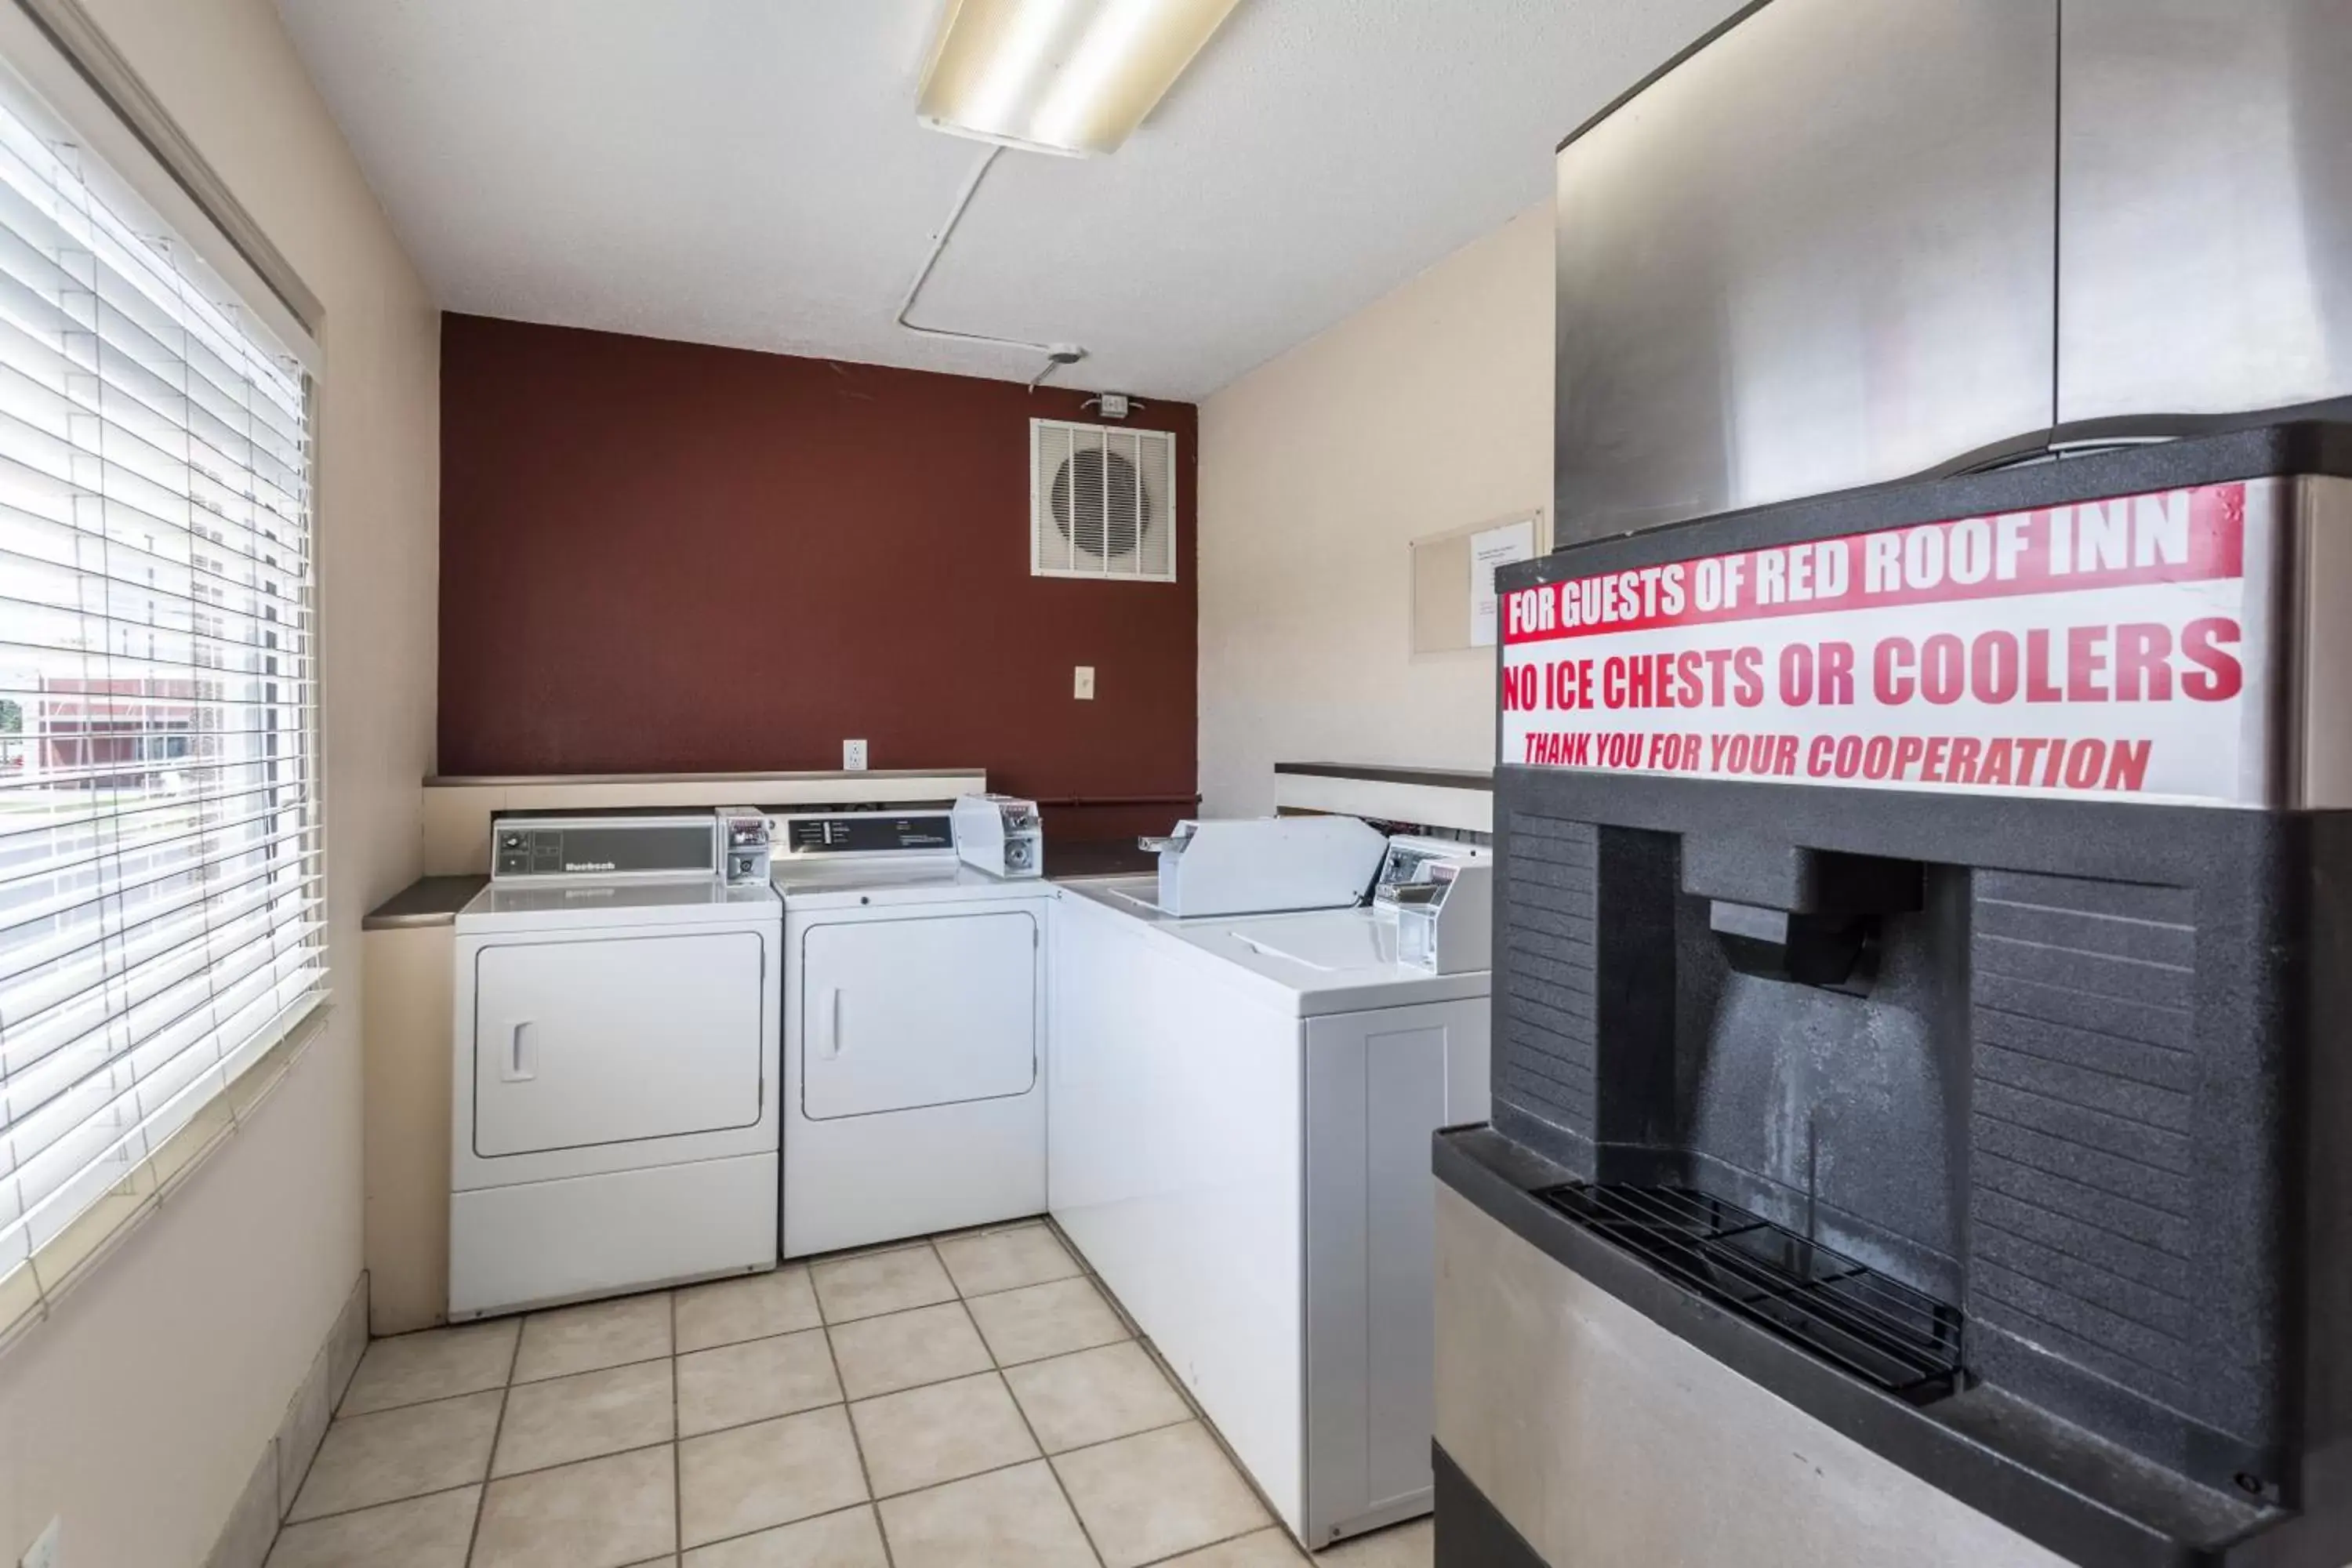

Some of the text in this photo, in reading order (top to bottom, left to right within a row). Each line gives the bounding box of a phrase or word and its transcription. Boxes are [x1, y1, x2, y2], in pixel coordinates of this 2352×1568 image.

[1508, 489, 2191, 635] FOR GUESTS OF RED ROOF INN
[1503, 616, 2242, 711] NO ICE CHESTS OR COOLERS
[1525, 731, 2153, 791] THANK YOU FOR YOUR COOPERATION
